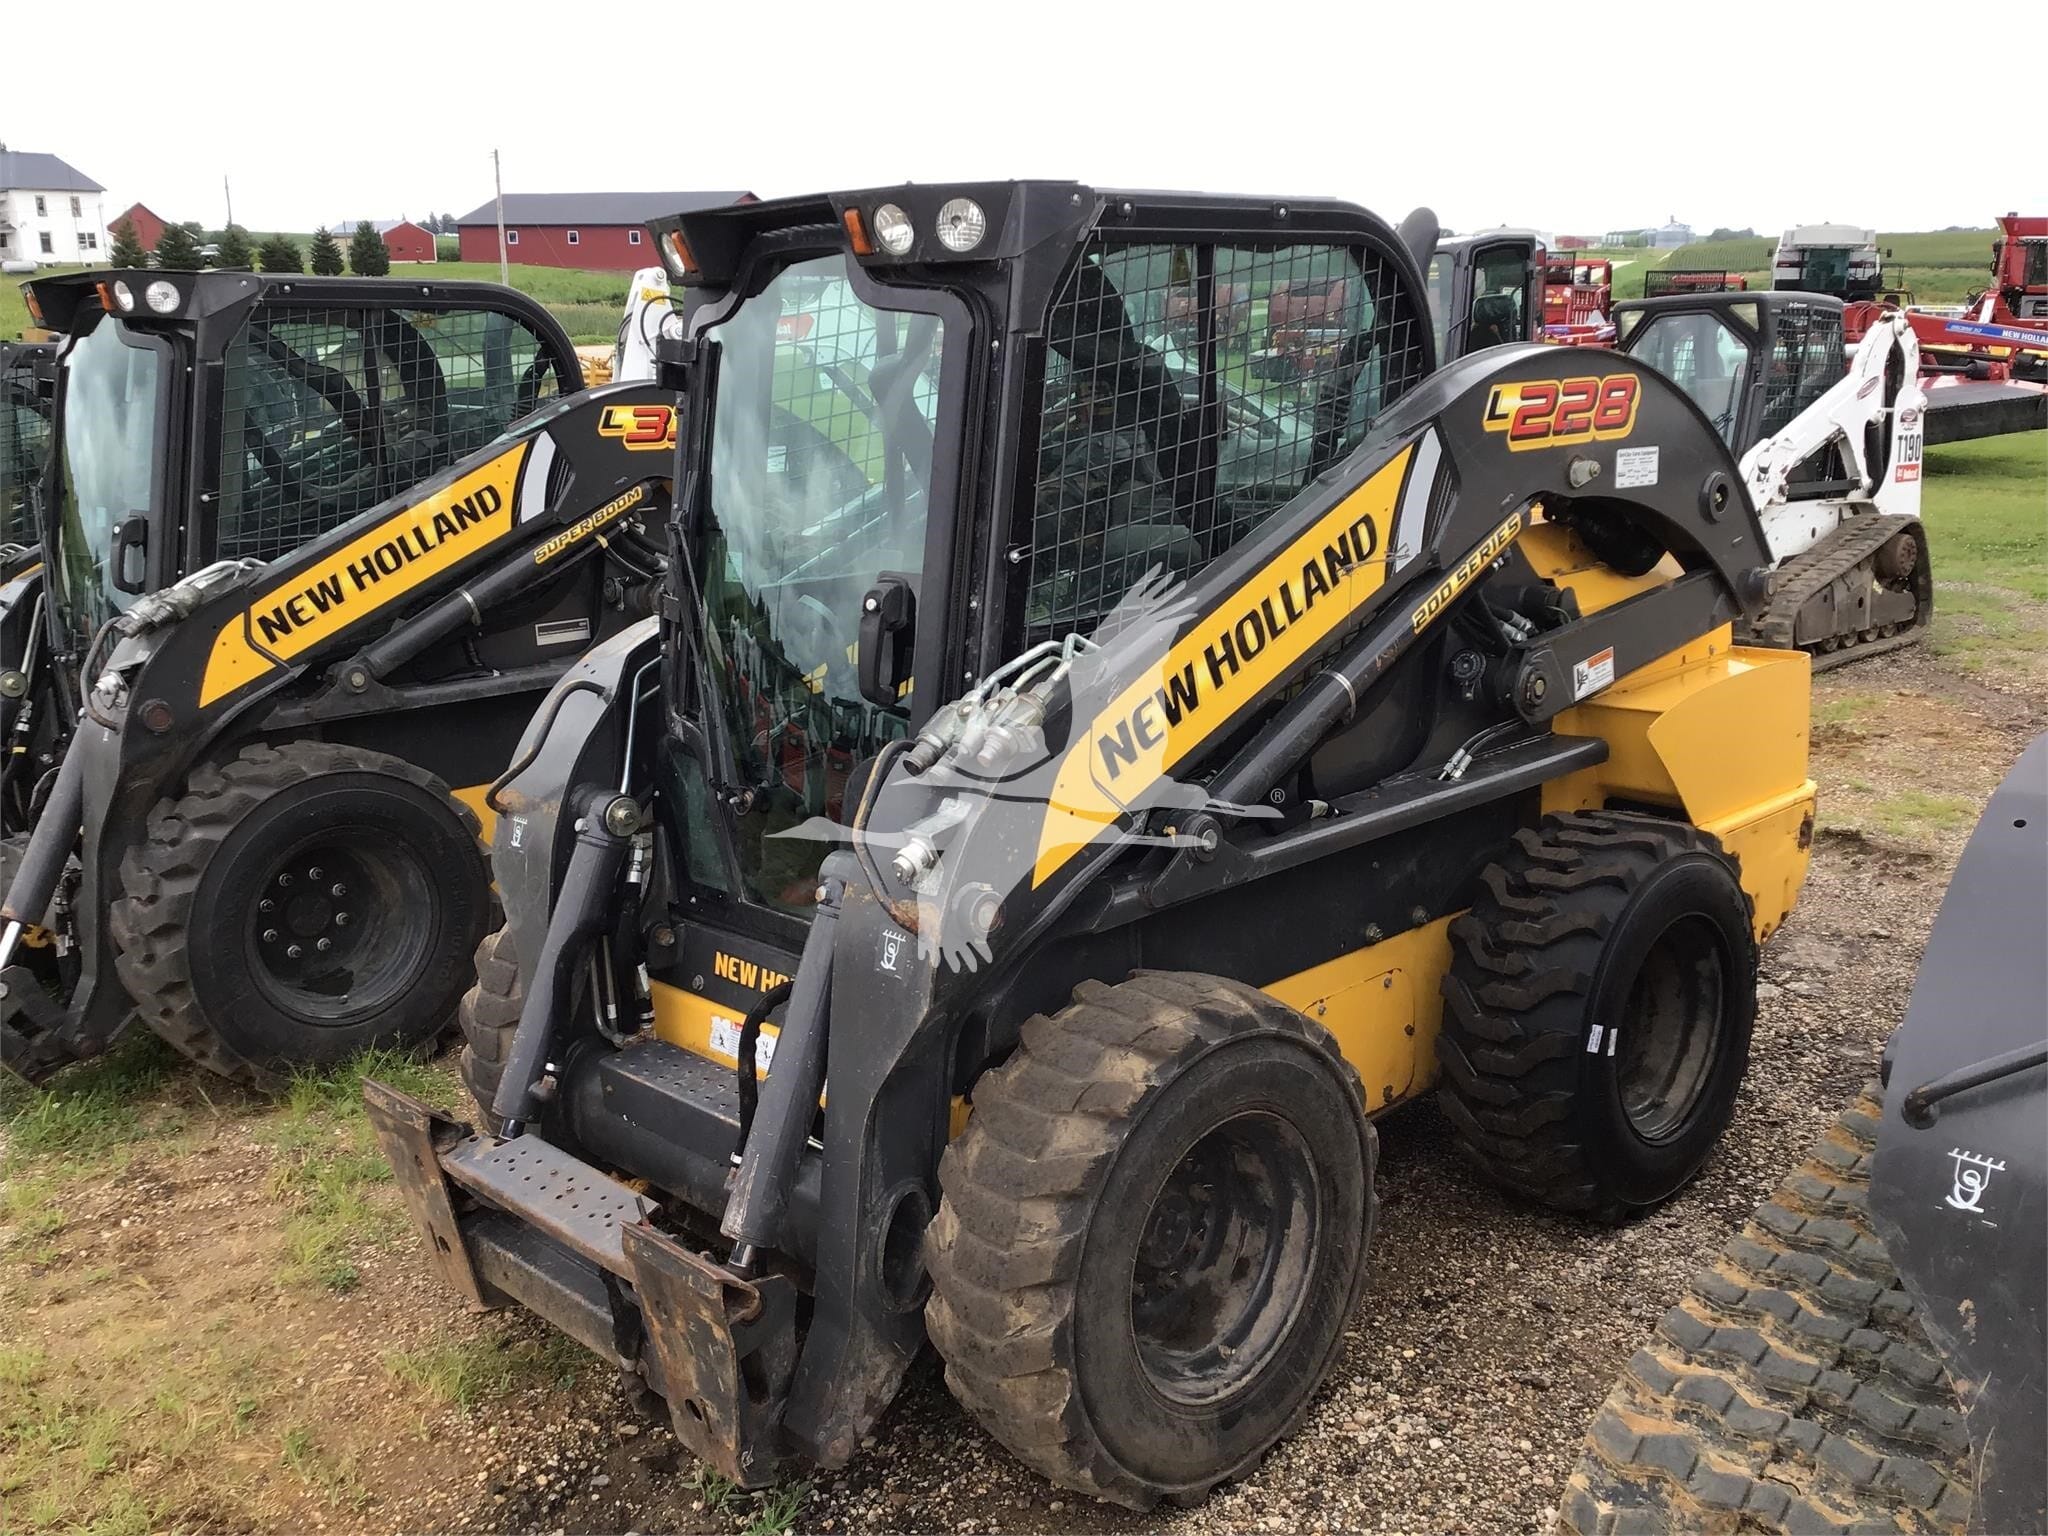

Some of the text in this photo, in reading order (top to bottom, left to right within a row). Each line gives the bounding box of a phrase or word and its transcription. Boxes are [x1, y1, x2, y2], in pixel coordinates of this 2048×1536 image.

[2001, 329, 2020, 340] NEW
[1484, 374, 1640, 449] L228
[1897, 433, 1922, 463] T190
[534, 486, 642, 564] SUPER BOOM
[256, 484, 503, 645] NEW HOLLAND
[1412, 512, 1521, 632] 200 SERIES
[1098, 513, 1378, 782] NEW HOLLAND
[714, 950, 759, 989] NEW
